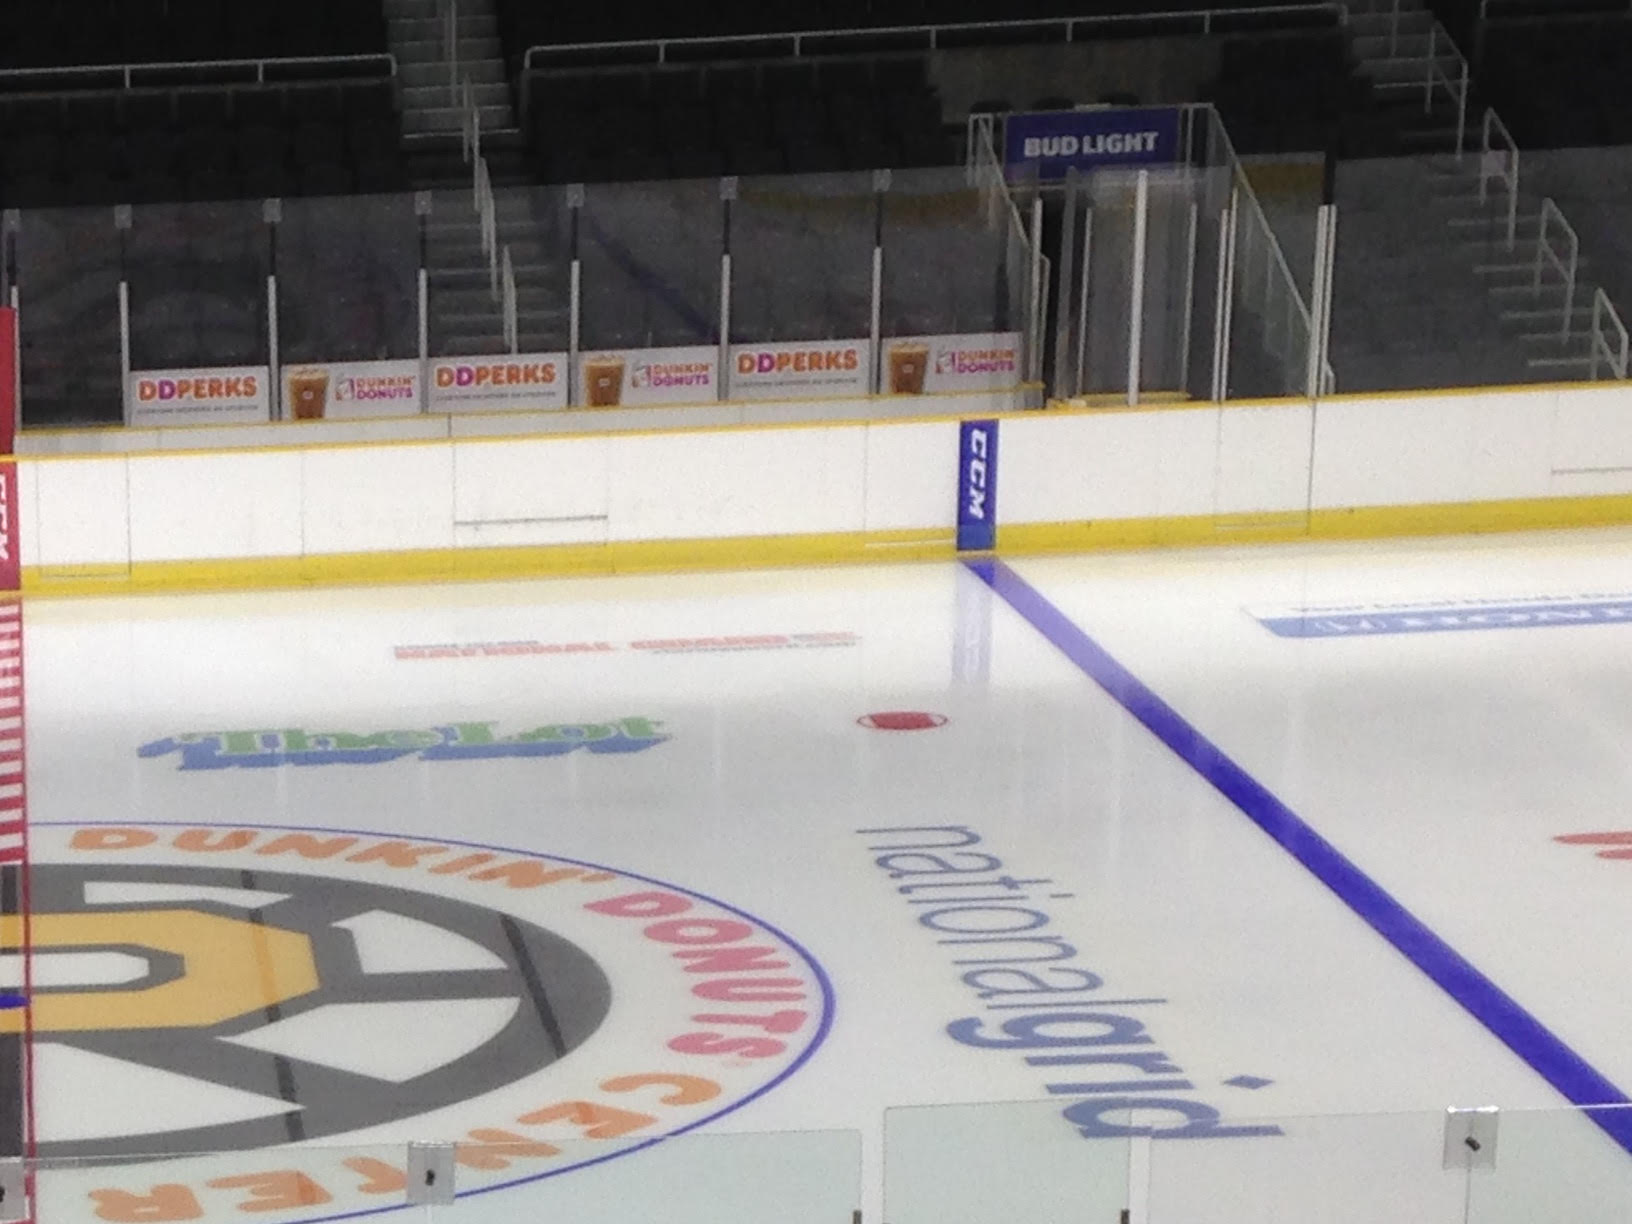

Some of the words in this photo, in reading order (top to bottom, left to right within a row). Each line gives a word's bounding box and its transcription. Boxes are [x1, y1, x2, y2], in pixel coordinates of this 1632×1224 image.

[1024, 135, 1079, 158] BUD
[1082, 131, 1160, 155] LIGHT
[955, 359, 1015, 374] DONUTS
[651, 373, 710, 387] DONUTS
[355, 386, 413, 400] DONUTS
[969, 428, 987, 519] CCM
[582, 891, 808, 1060] DONUTS
